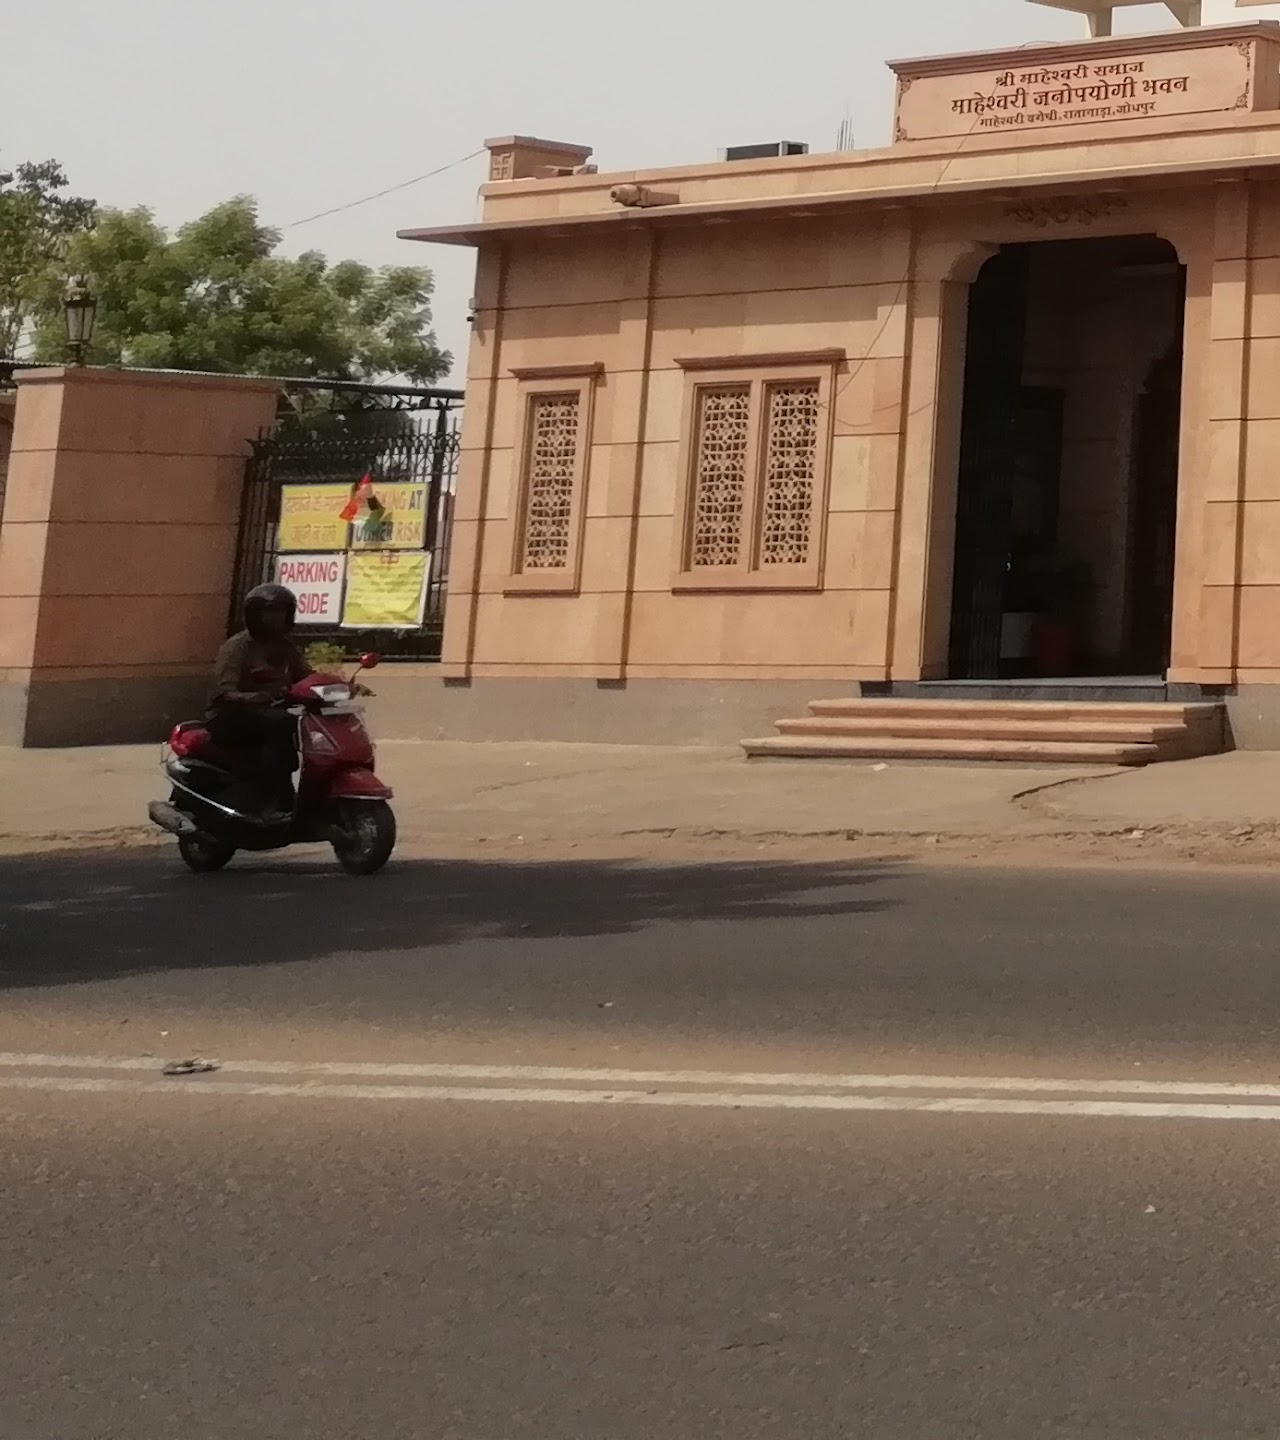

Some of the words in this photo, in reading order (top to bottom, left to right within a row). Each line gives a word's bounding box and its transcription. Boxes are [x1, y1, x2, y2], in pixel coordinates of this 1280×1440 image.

[995, 71, 1016, 87] श्री
[1020, 64, 1089, 85] माहेश्वरी
[1093, 61, 1145, 76] समाज
[951, 87, 1029, 115] माहेश्वरी
[1032, 76, 1138, 106] जनोपयोगी
[1142, 76, 1190, 95] भवन
[408, 489, 423, 511] AT
[279, 561, 338, 583] PARKING
